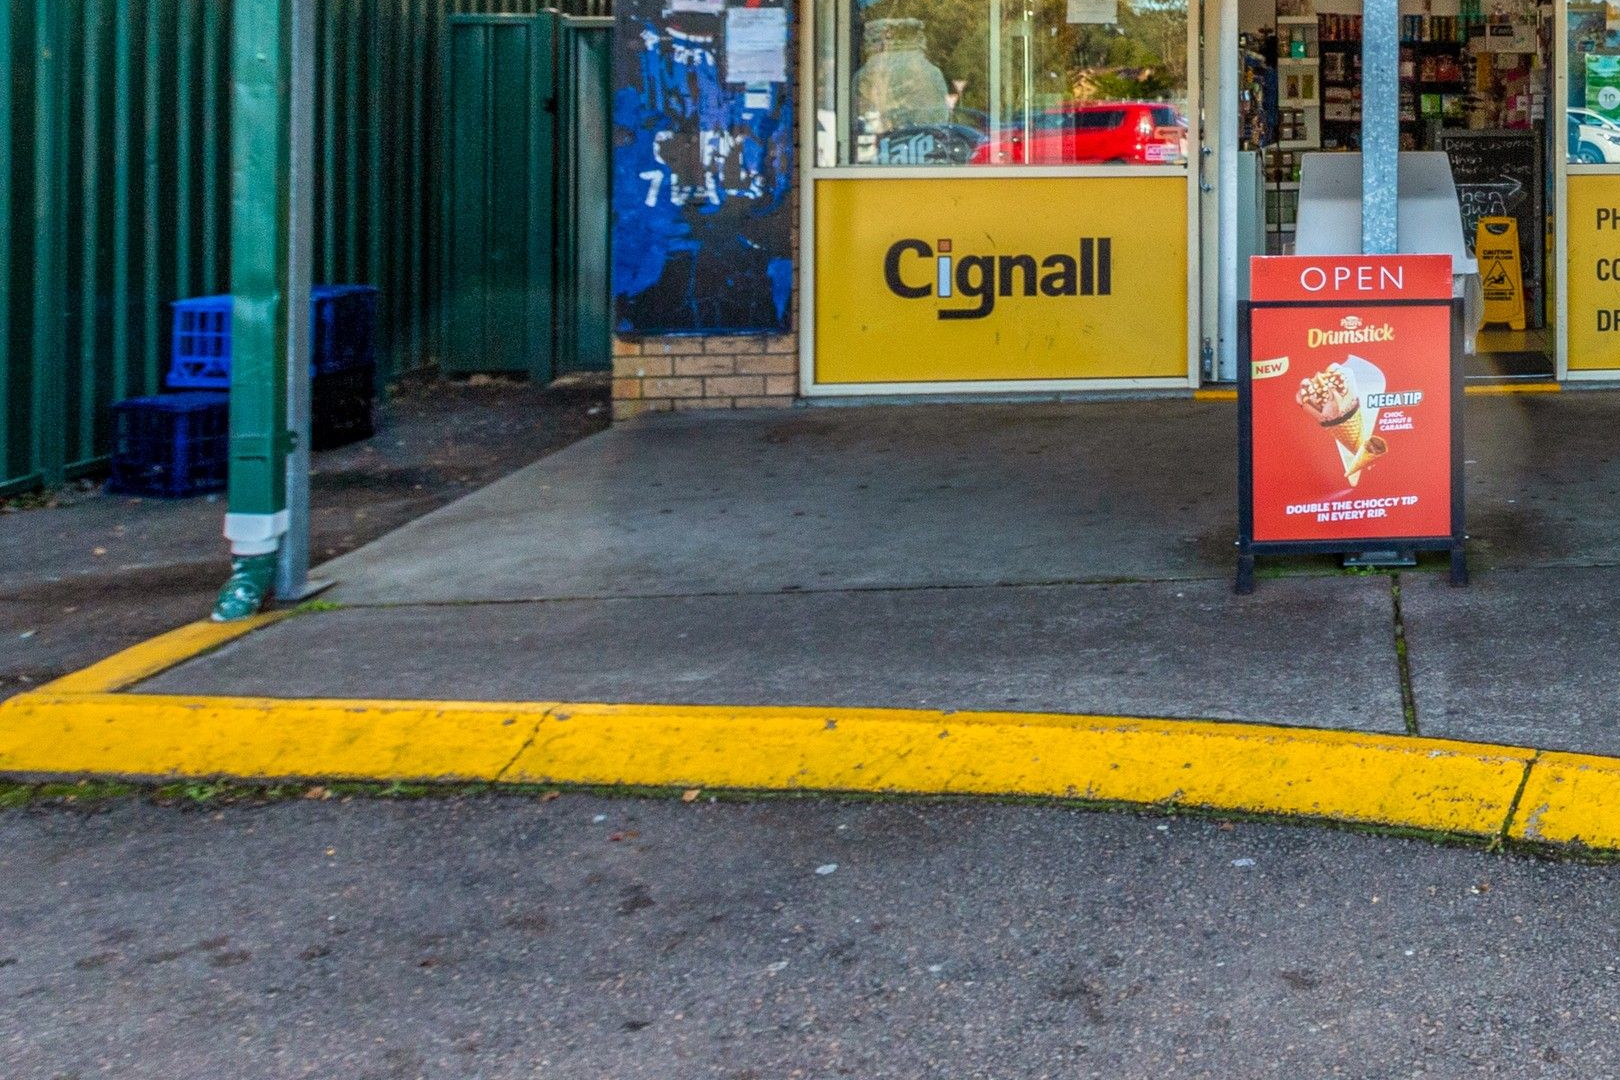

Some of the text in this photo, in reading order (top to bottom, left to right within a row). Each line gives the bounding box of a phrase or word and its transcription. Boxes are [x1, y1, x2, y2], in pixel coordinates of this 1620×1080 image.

[1604, 93, 1616, 102] 10
[884, 236, 1111, 320] Cignall
[1300, 265, 1404, 292] OPEN
[1307, 323, 1395, 348] Drumstick
[1255, 362, 1282, 375] NEW
[1368, 392, 1422, 408] MEGA TIP
[1379, 417, 1406, 425] PEANUT
[1380, 423, 1414, 431] CARAMEL
[1286, 495, 1418, 515] DOUBLE THE CHOCCY TIP
[1317, 508, 1387, 522] IN EVERY RIP.
